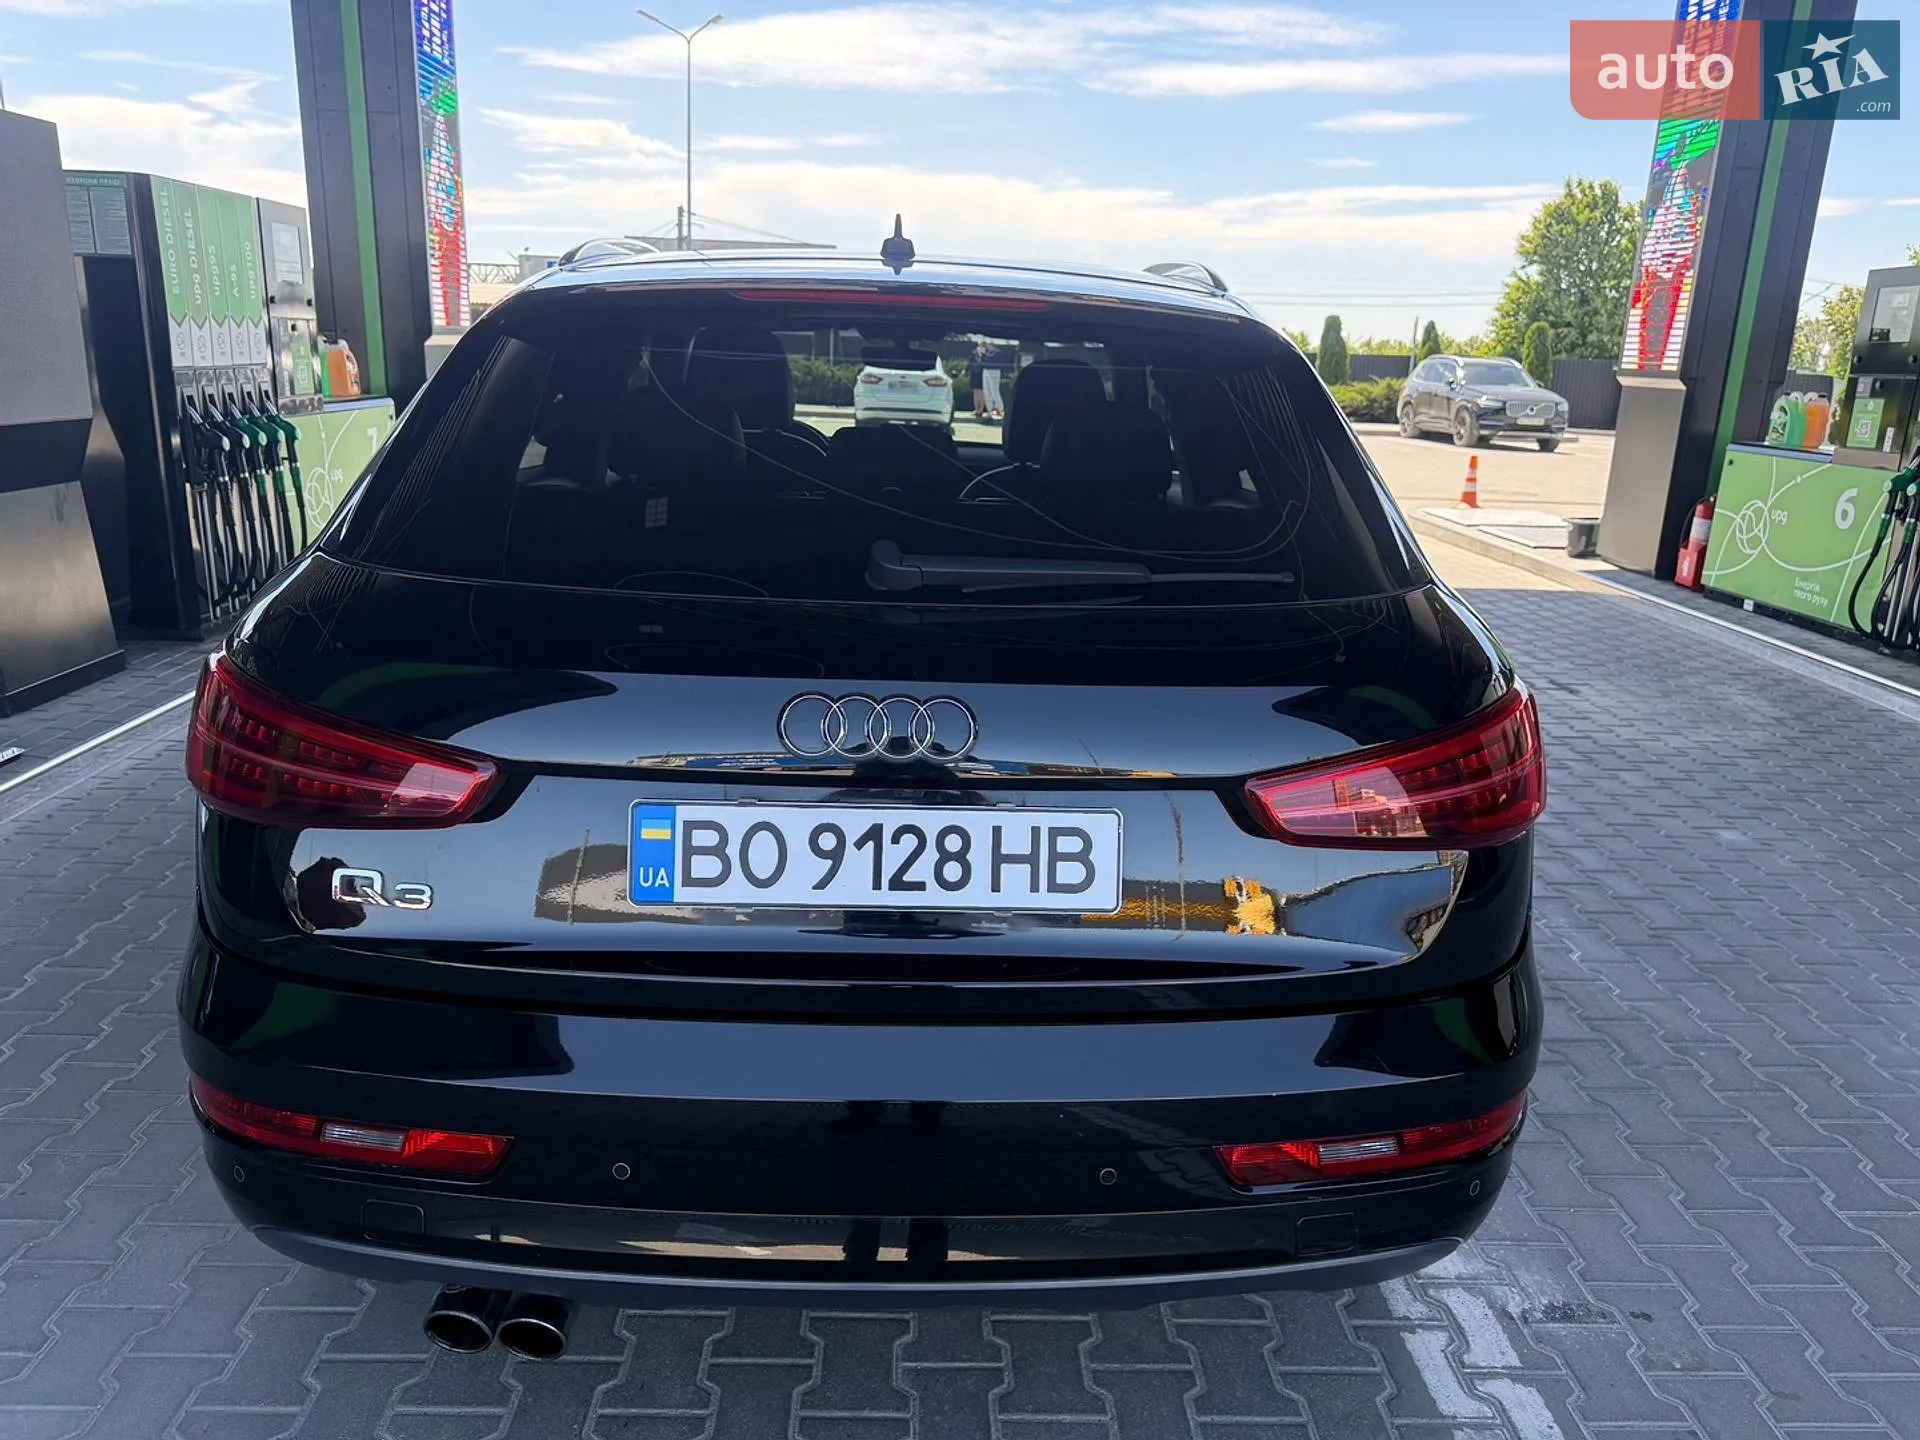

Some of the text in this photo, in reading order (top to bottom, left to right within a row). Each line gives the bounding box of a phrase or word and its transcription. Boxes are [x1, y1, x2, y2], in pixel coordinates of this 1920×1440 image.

[160, 187, 180, 295] EURO DIESEL
[183, 207, 202, 304] upg DIESEL
[207, 245, 220, 296] upg95
[244, 241, 257, 299] upg100
[366, 427, 378, 456] 7
[1771, 508, 1788, 525] upg
[1834, 487, 1858, 530] 6
[638, 866, 670, 888] UA
[682, 820, 1096, 895] BO 9128 HB
